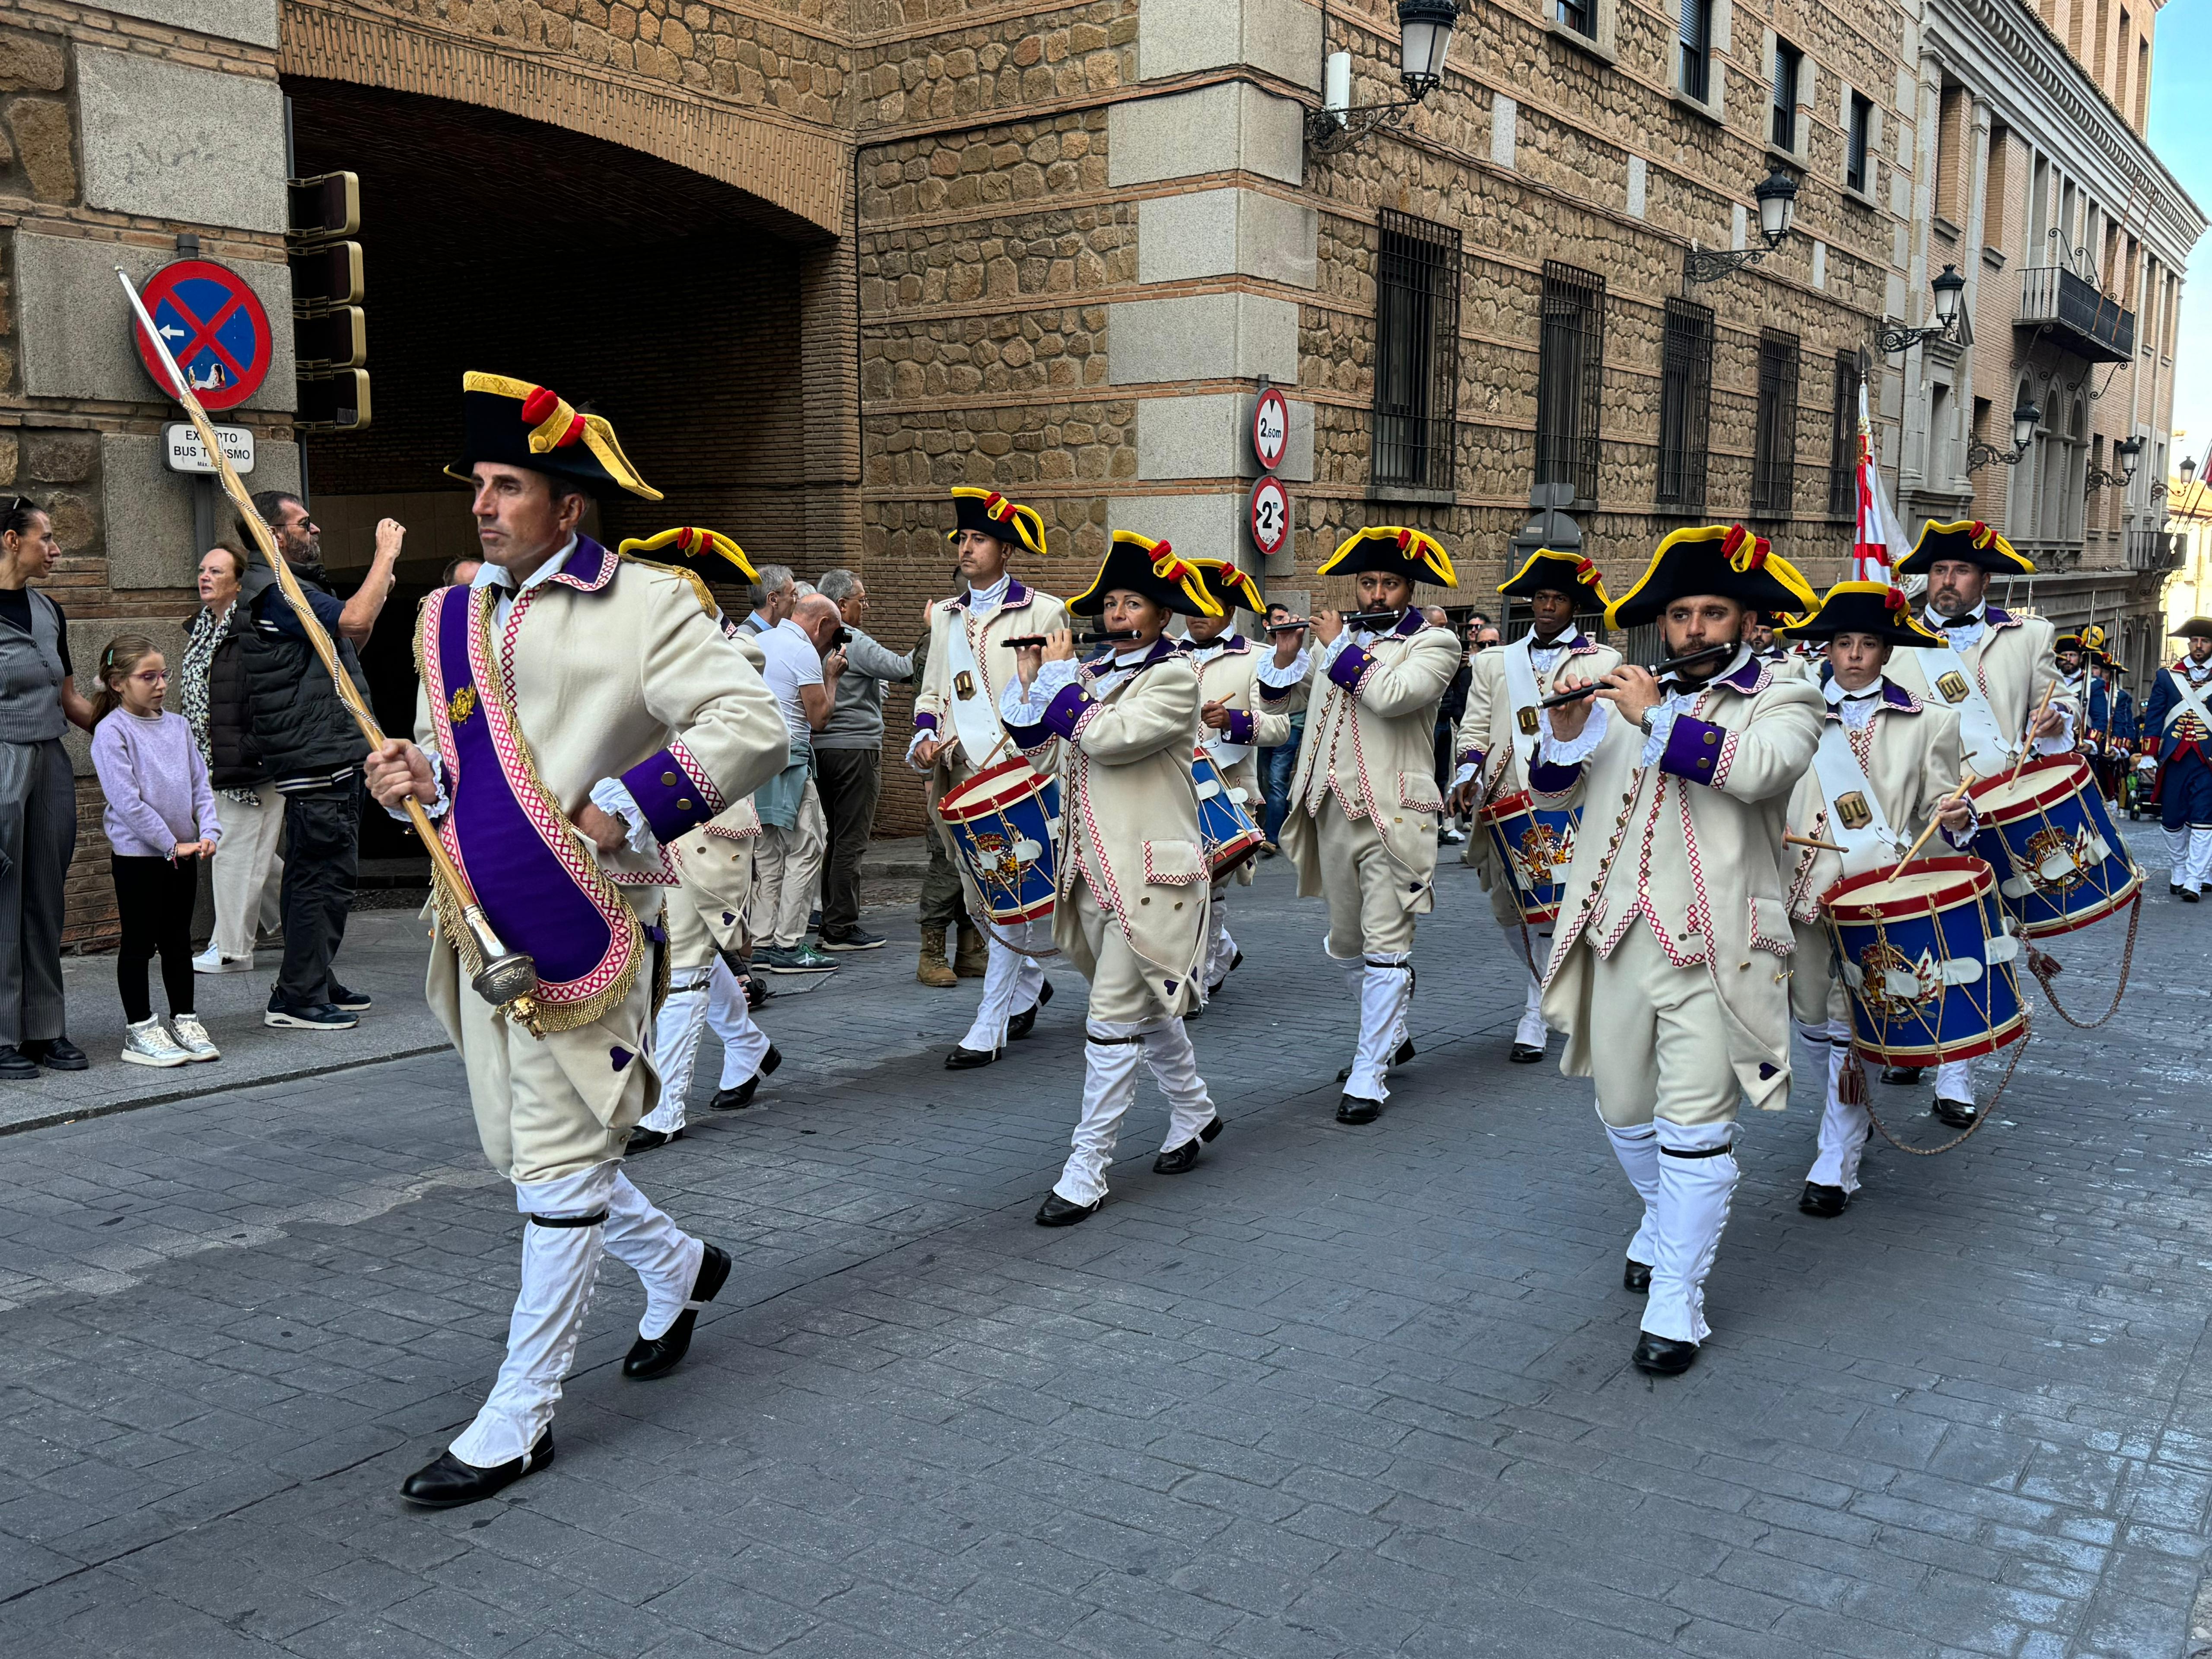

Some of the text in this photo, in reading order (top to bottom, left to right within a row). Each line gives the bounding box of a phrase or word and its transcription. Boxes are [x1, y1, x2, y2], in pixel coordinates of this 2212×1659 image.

[1261, 418, 1281, 439] 2,60m
[186, 430, 238, 443] EXTO
[174, 446, 250, 460] BUS TSMO
